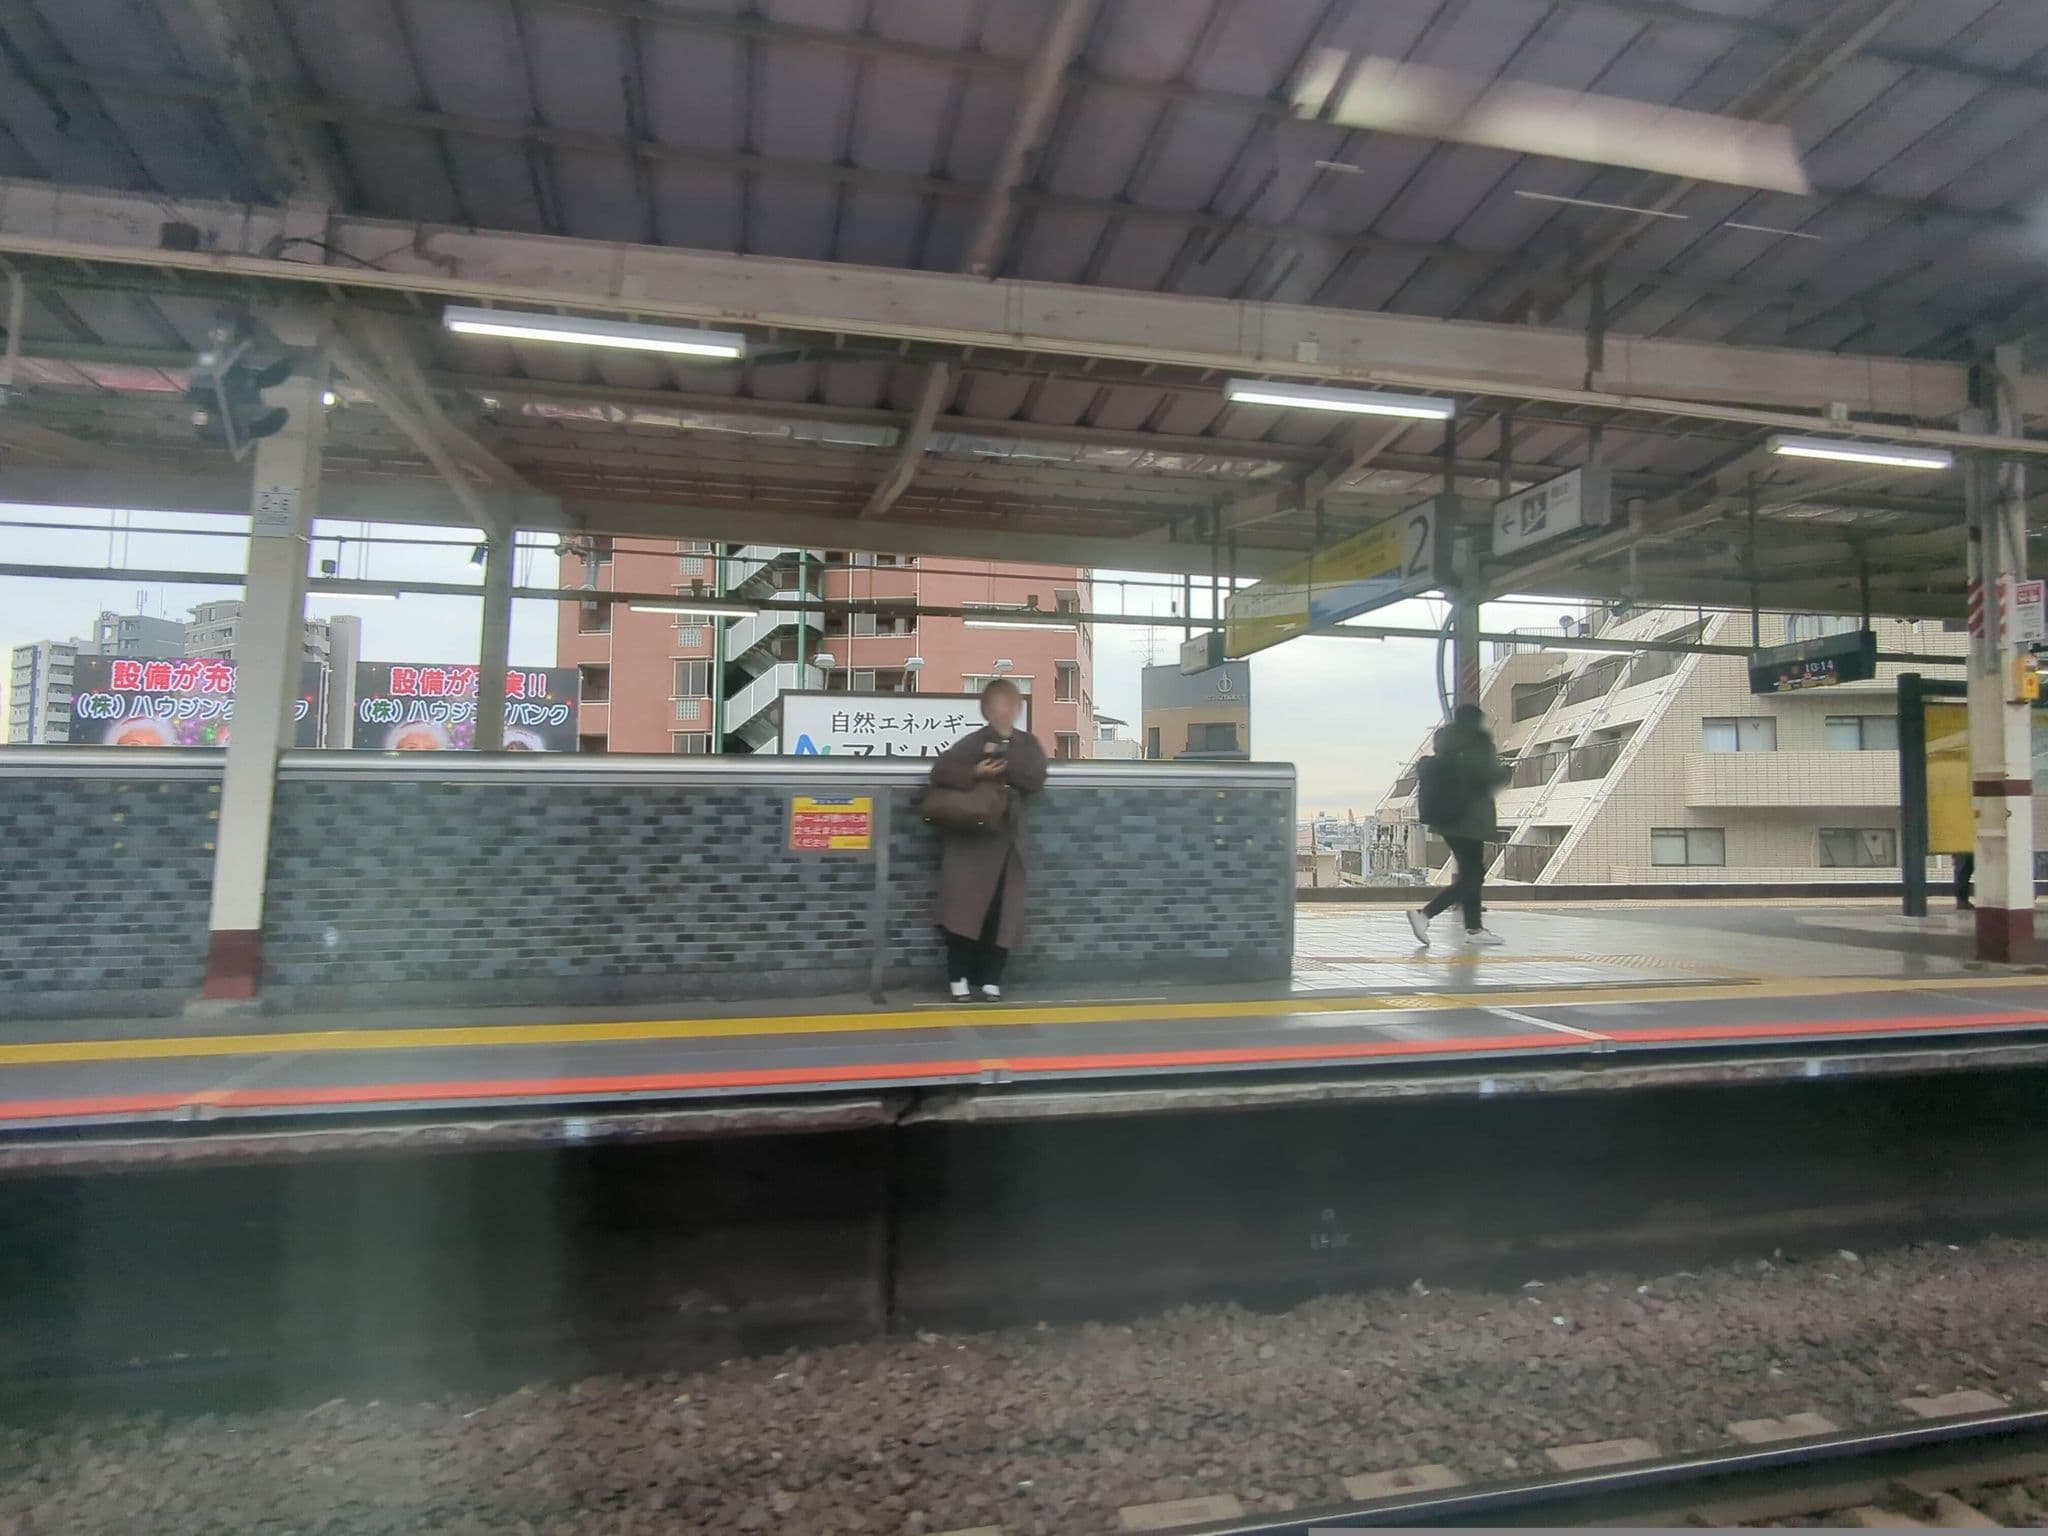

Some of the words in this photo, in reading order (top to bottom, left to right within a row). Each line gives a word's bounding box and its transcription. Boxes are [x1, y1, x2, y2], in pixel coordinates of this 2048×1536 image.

[1408, 515, 1429, 577] 2
[112, 660, 238, 691] 設備が充
[391, 667, 547, 698] 設備が実!!
[359, 698, 569, 725] (株)ハウジバンク
[831, 711, 988, 735] 自然エネルギー
